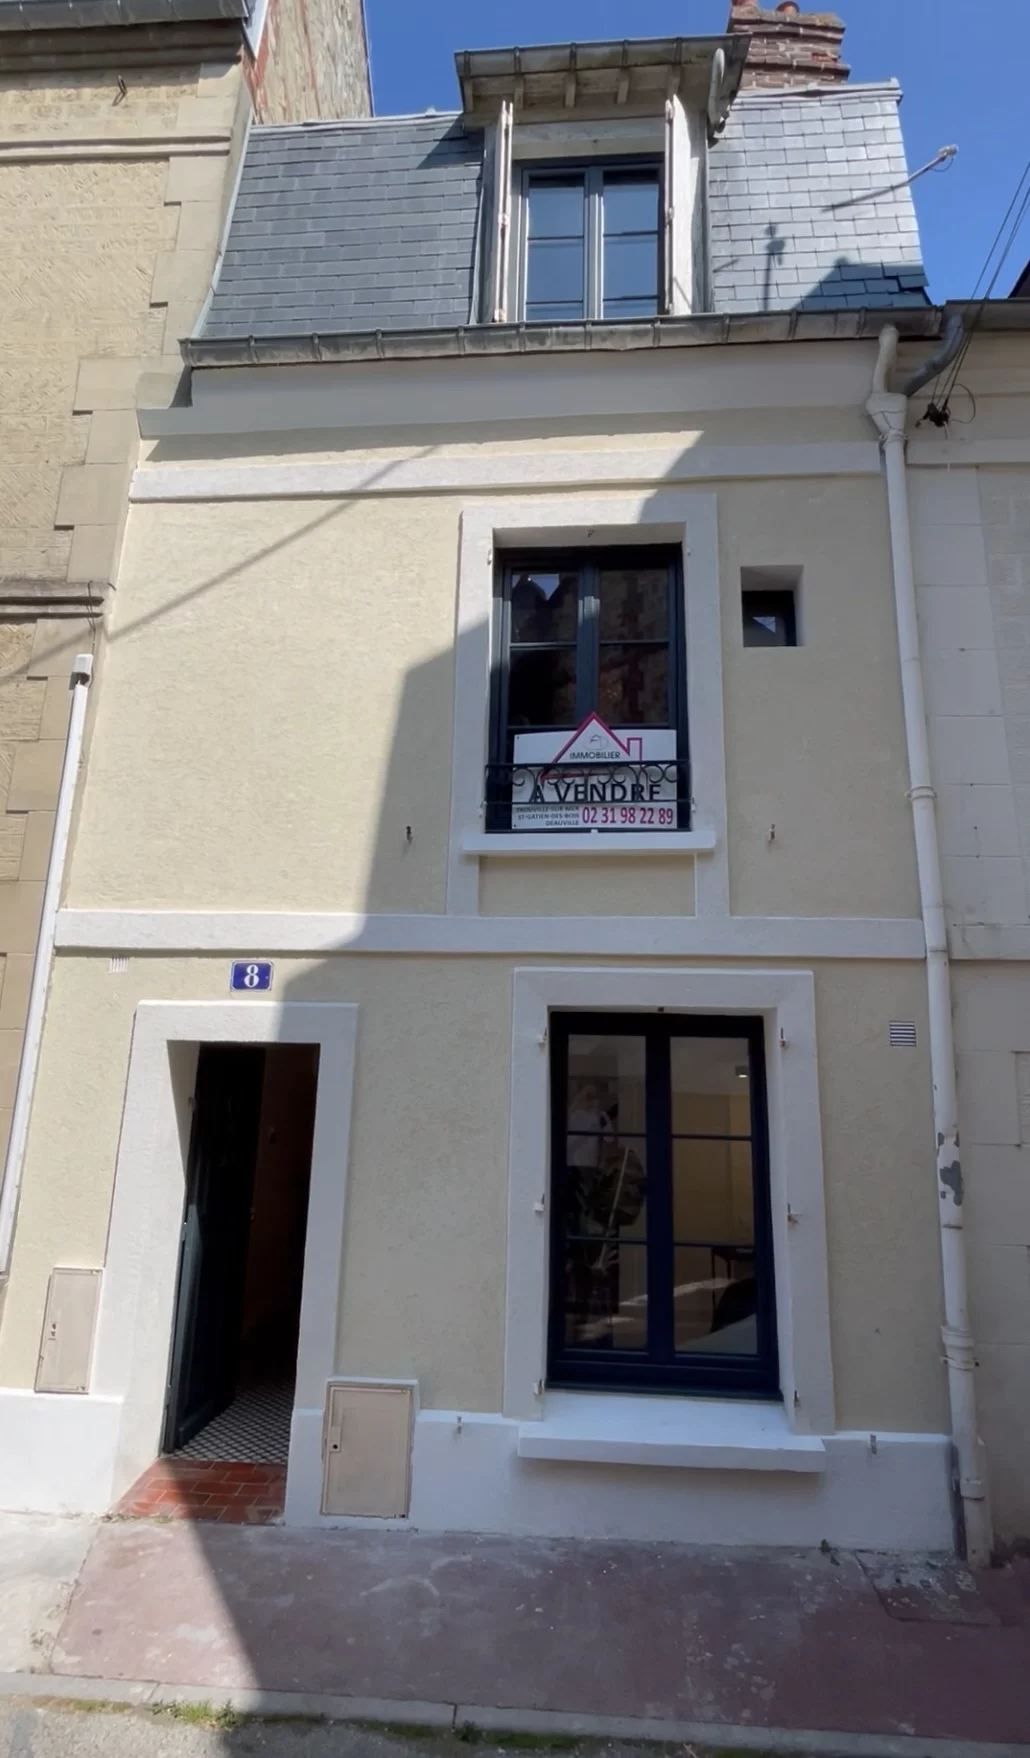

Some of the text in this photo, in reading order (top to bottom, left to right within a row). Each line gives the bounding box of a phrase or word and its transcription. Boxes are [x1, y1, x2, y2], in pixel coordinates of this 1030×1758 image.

[569, 751, 621, 759] IMMOBILIER
[554, 783, 661, 802] VENDRE
[582, 807, 673, 825] 02 31 98 22 89
[244, 964, 260, 988] 8
